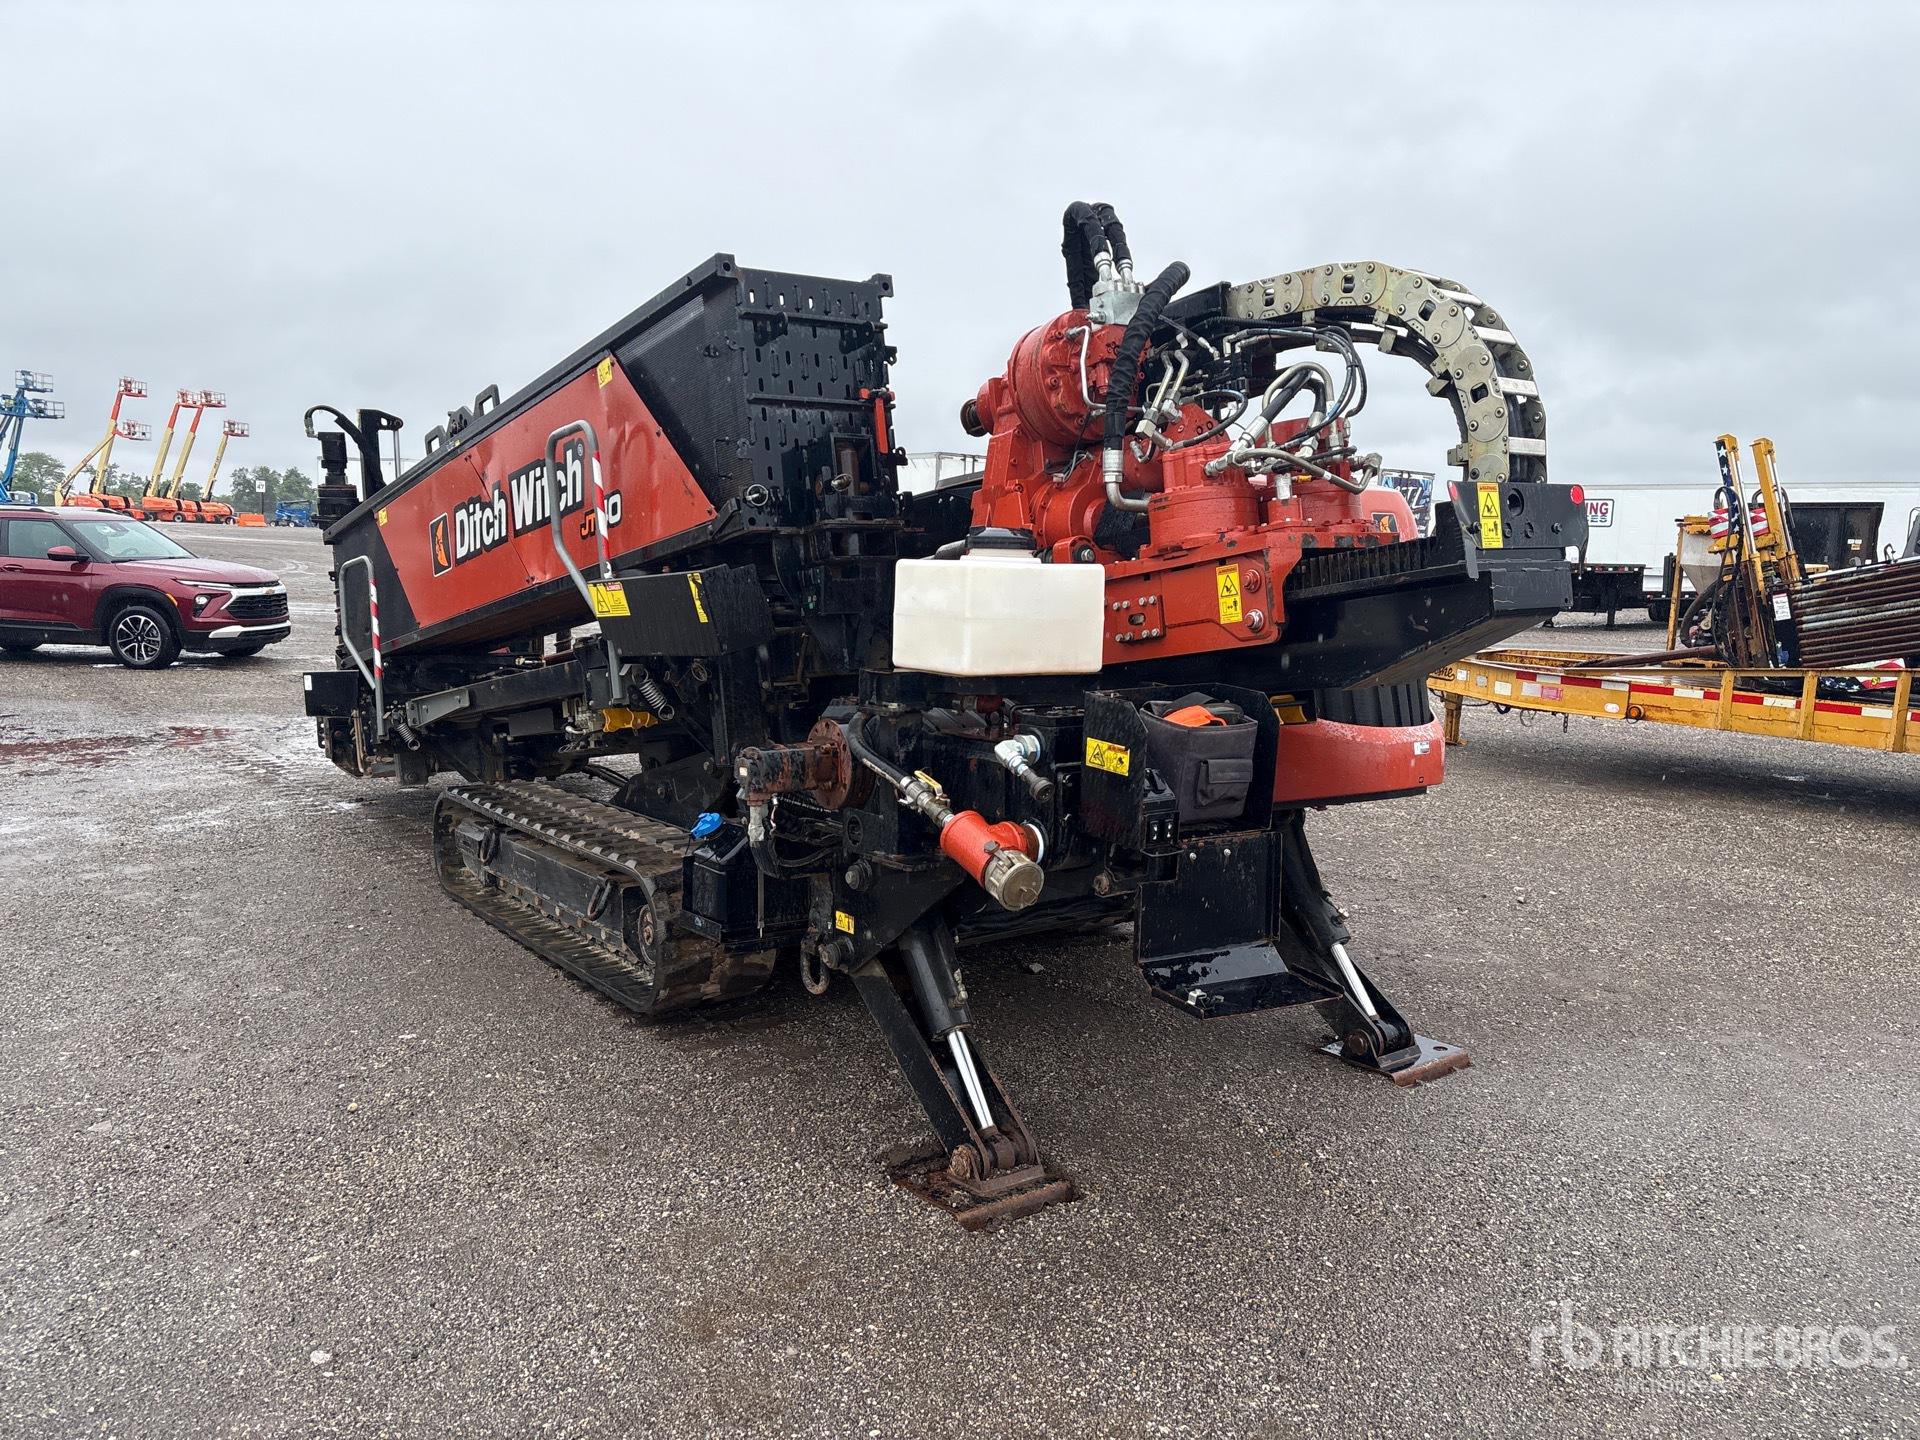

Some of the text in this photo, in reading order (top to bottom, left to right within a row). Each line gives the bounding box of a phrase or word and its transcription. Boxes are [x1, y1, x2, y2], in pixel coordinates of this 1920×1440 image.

[455, 448, 582, 560] Ditch Witch
[581, 493, 622, 537] JT0
[1587, 514, 1608, 523] ES
